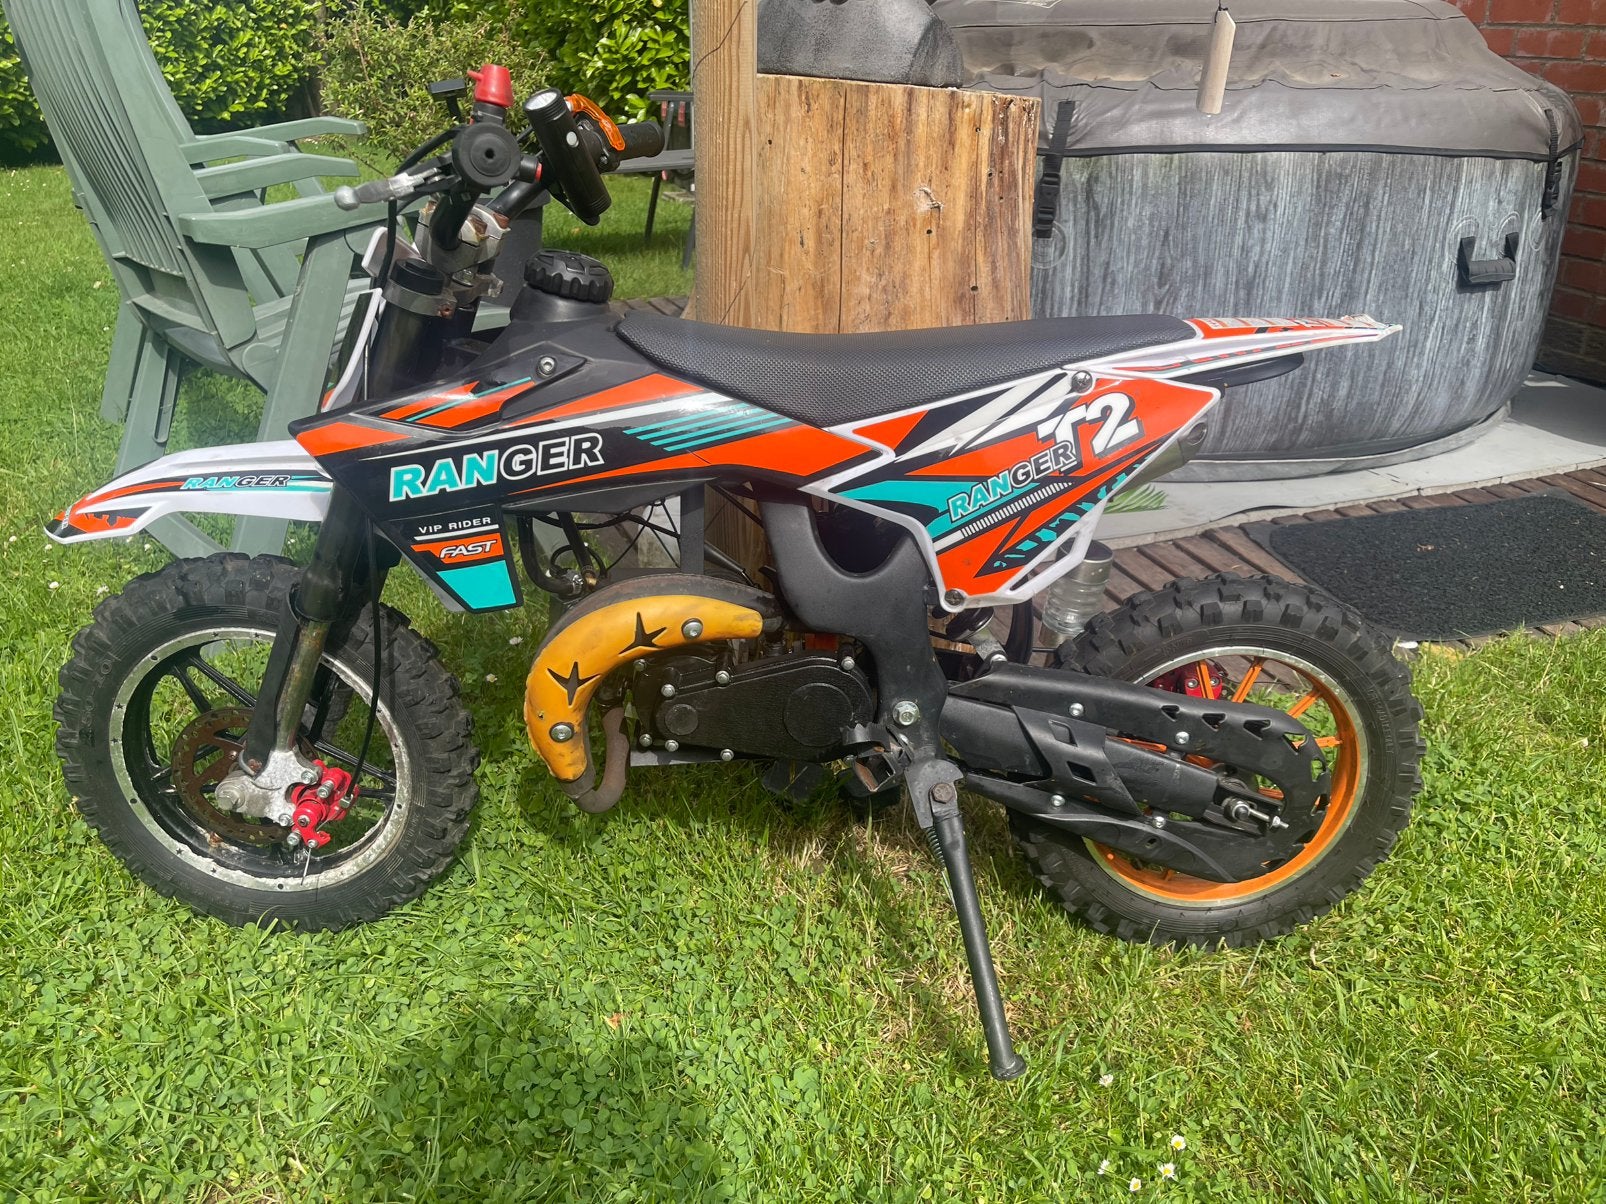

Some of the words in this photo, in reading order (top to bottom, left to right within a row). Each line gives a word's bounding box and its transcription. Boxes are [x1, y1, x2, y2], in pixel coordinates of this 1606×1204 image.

[1037, 392, 1143, 472] T2
[179, 474, 291, 490] RANGER
[388, 432, 605, 503] RANGER
[947, 439, 1076, 522] RANGER
[418, 524, 443, 534] VIP
[448, 516, 492, 530] RIDER
[439, 539, 497, 560] FAST
